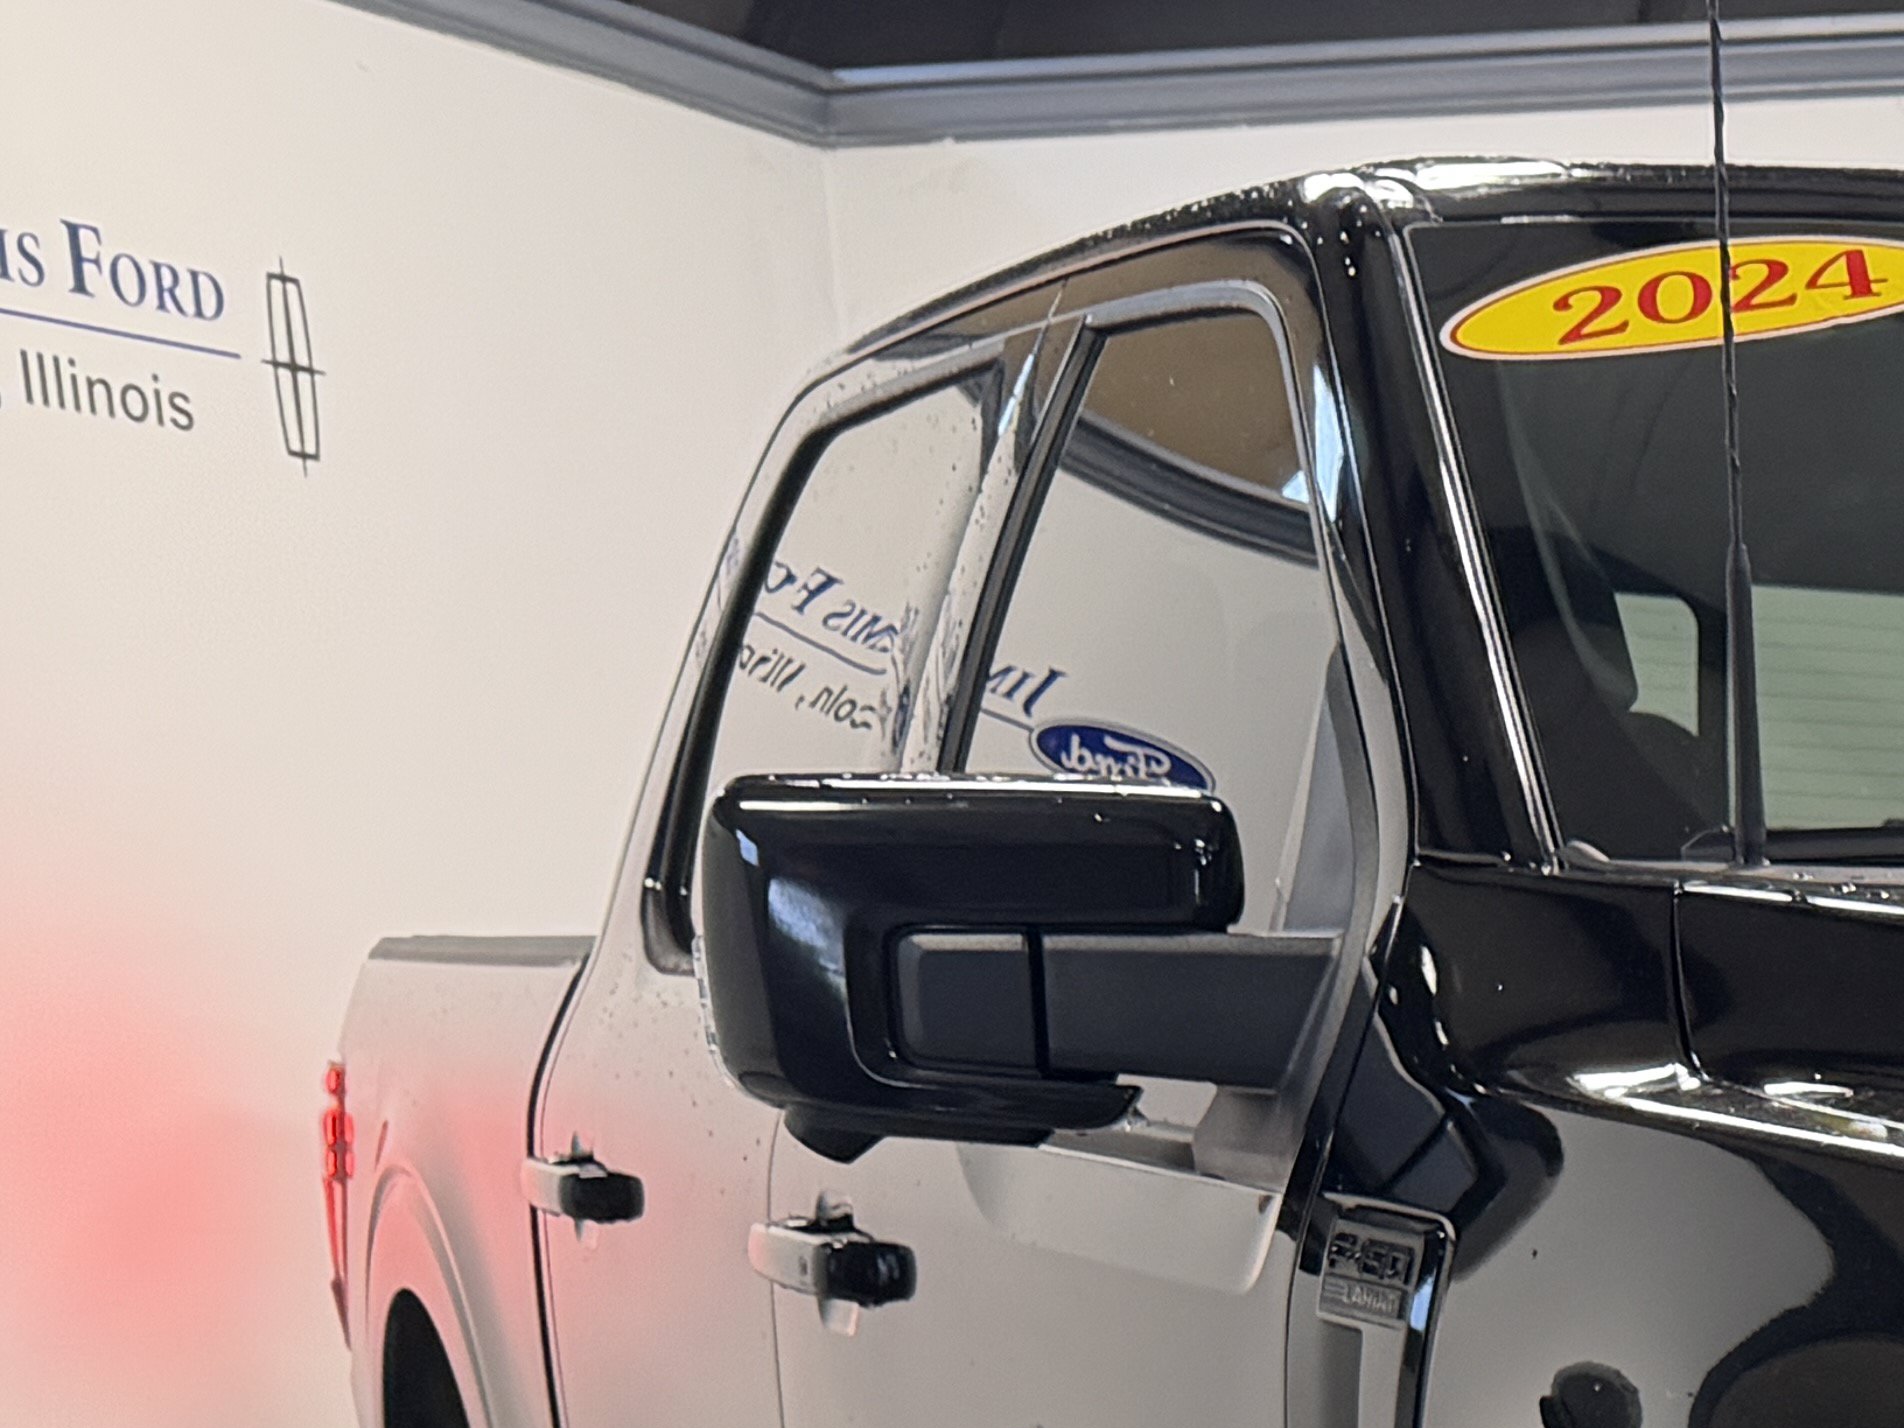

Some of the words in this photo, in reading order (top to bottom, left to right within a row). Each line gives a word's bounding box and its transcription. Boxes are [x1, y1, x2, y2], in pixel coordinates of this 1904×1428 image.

[60, 217, 226, 322] FORD
[1551, 247, 1889, 347] 2024
[19, 347, 195, 432] Illinois
